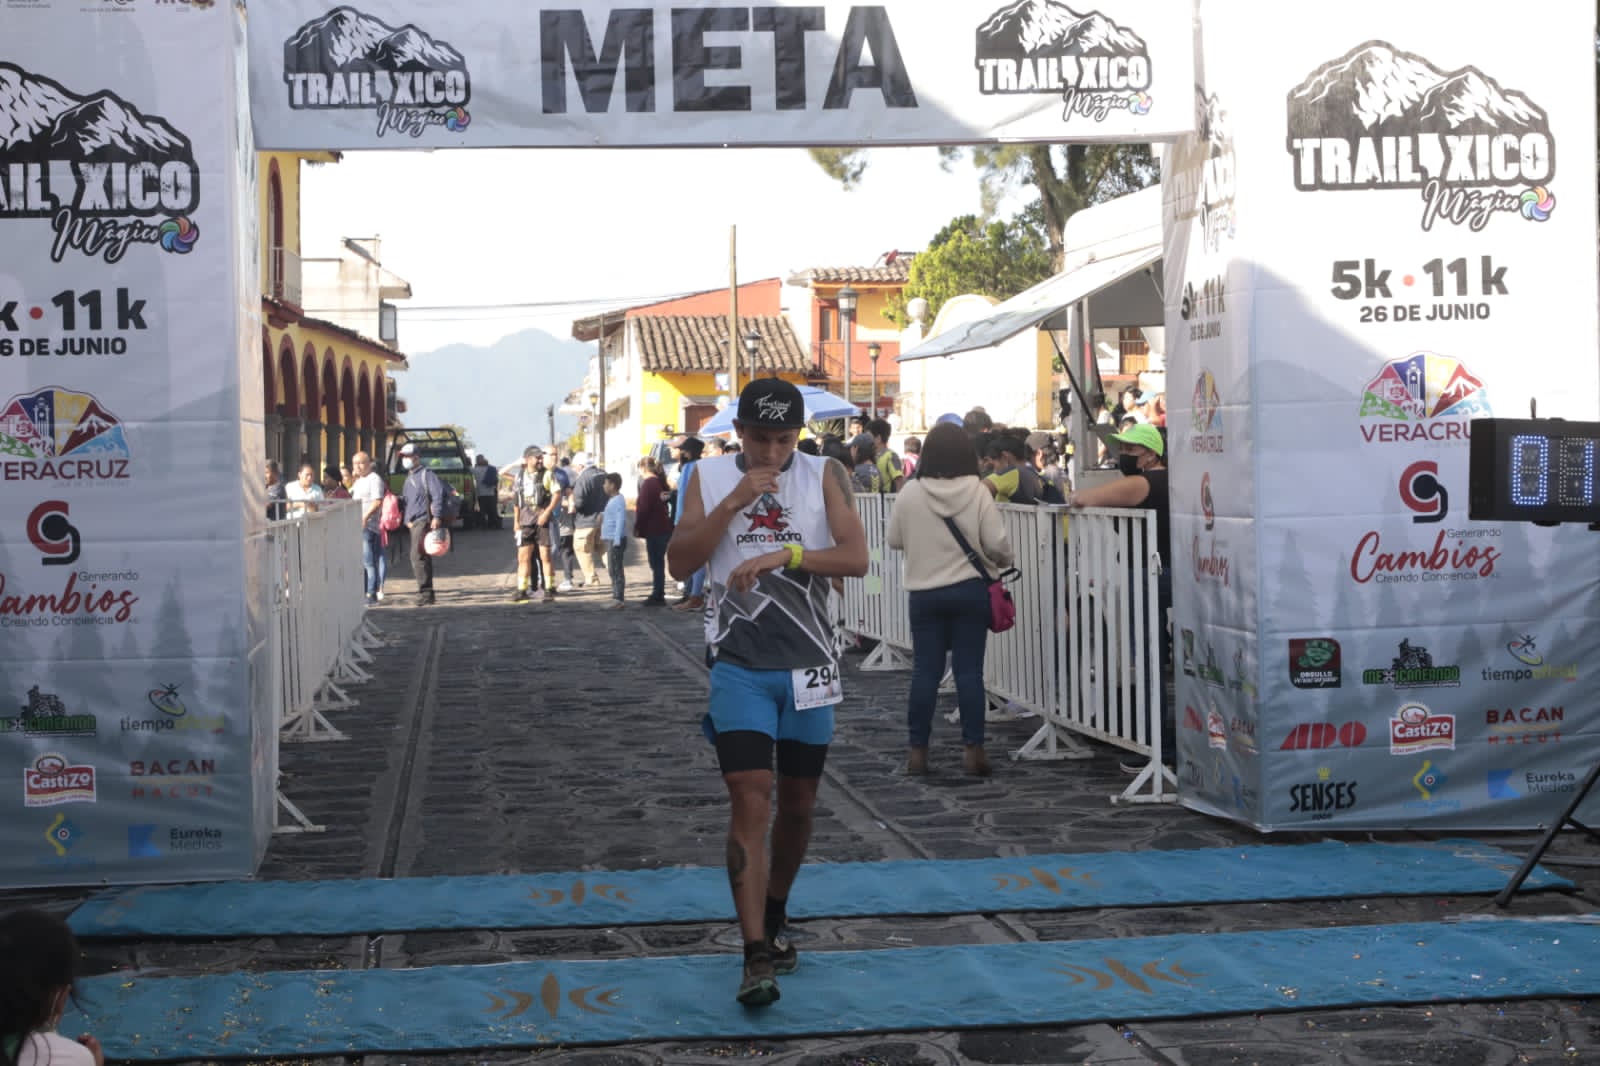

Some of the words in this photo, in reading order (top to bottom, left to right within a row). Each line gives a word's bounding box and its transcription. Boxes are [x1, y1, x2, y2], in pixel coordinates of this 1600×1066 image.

[539, 5, 919, 114] META
[979, 57, 1063, 91] TRAIL
[1079, 55, 1148, 89] XICO
[288, 71, 377, 105] TRAIL
[393, 70, 466, 104] XICO
[1293, 136, 1421, 185] TRAIL
[1446, 132, 1549, 181] XICO
[78, 161, 191, 210] XICO
[1330, 258, 1393, 300] 5k
[1360, 305, 1388, 323] 26
[1393, 304, 1421, 322] DE
[1425, 303, 1490, 321] JUNIO
[19, 338, 50, 356] DE
[54, 337, 127, 356] JUNIO
[0, 459, 130, 481] ERACRUZ
[1447, 528, 1502, 539] Generando
[1351, 530, 1501, 584] Cambios
[78, 570, 139, 582] Generando
[1375, 572, 1419, 584] Creando
[0, 572, 139, 623] ambios
[1486, 706, 1564, 724] BACAN
[1280, 721, 1367, 750] ADO
[130, 759, 214, 776] BACAN
[1526, 771, 1575, 783] Eureka
[1289, 781, 1358, 812] SENSES
[169, 826, 222, 839] Eureka
